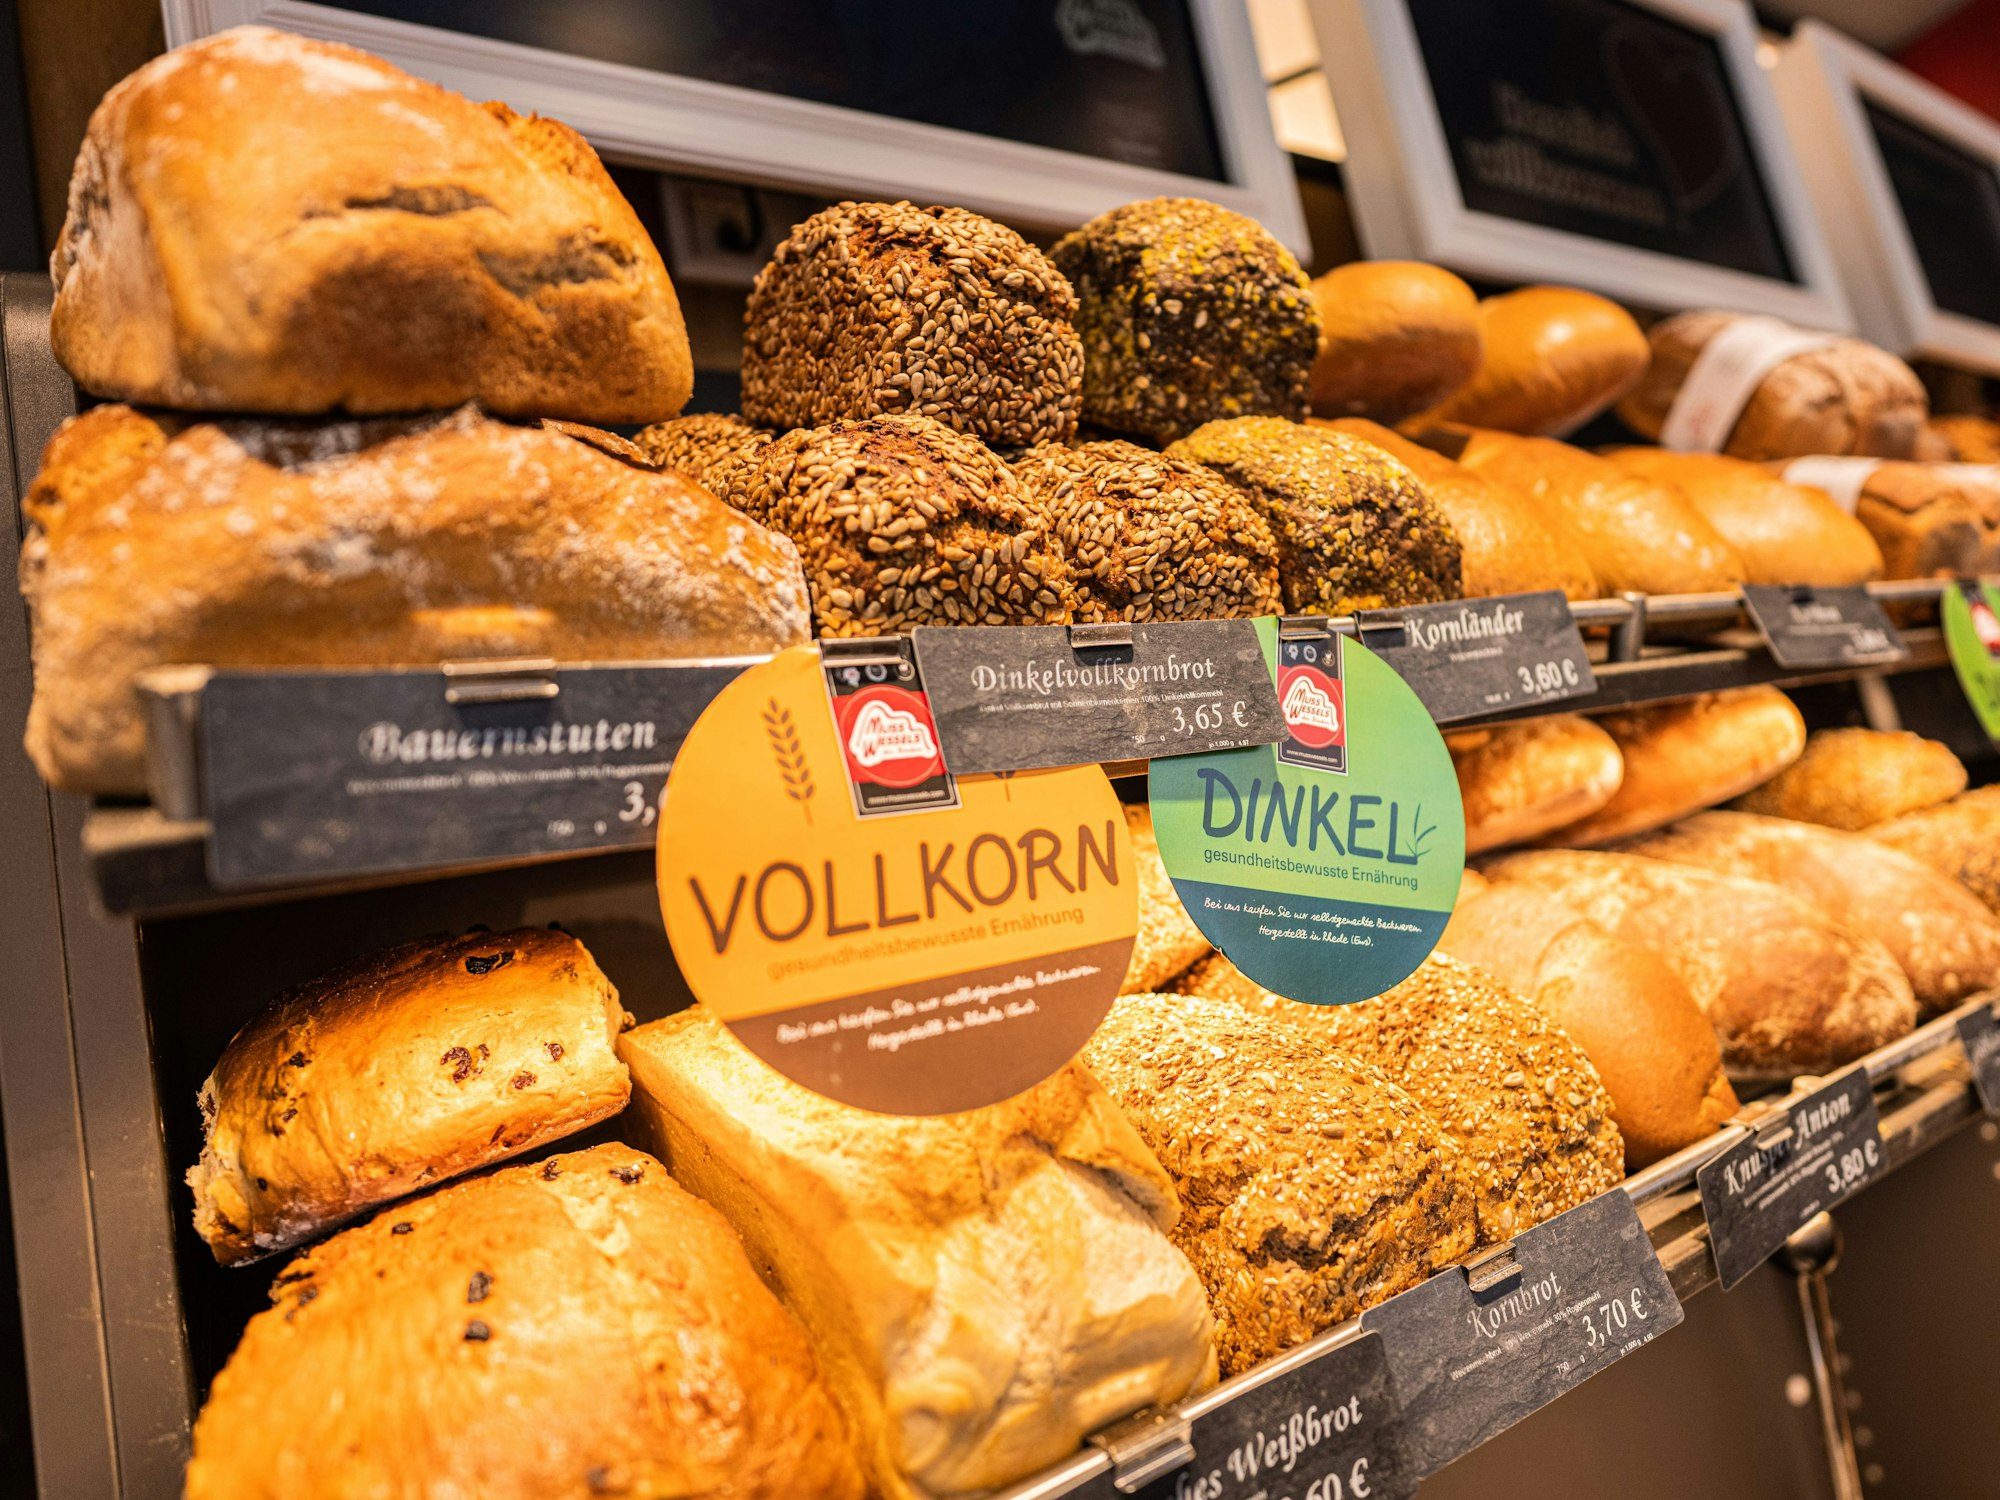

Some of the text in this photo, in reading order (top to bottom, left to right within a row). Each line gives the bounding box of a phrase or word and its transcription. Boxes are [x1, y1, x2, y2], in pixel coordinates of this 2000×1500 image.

[1405, 603, 1525, 651] Kornländer
[970, 654, 1216, 696] Dinkelvollkornbrot
[1517, 661, 1562, 695] 3,60
[1562, 658, 1579, 686] €
[1172, 700, 1249, 736] 3,65 €
[1289, 697, 1331, 719] WESSELS
[1294, 688, 1321, 706] MUSS
[359, 718, 658, 764] Bauernstuten
[1132, 735, 1146, 744] 50
[1197, 768, 1418, 865] DINKEL
[688, 820, 1119, 954] VOLLKORN
[1203, 848, 1419, 891] gesundheitsbewusste Ernährung
[1204, 897, 1222, 910] Bei
[1224, 902, 1241, 912] uns
[1243, 902, 1276, 917] kaufen
[1277, 906, 1291, 918] Sie
[1310, 911, 1375, 928] selbstgemachte
[1376, 917, 1423, 933] Backwaren.
[1258, 924, 1374, 947] Hergestellt in Rhede (Ems).
[767, 905, 1086, 982] gesundheitsbewusste Ernährung
[1794, 1092, 1851, 1150] Anton
[1825, 1147, 1865, 1194] 3,80
[1864, 1139, 1879, 1168] €
[1466, 1271, 1562, 1339] Kornbrot
[1582, 1287, 1648, 1347] 3,70 €
[1556, 1354, 1586, 1375] 750 g
[1227, 1395, 1363, 1482] Weißbrot
[1349, 1456, 1371, 1499] €
